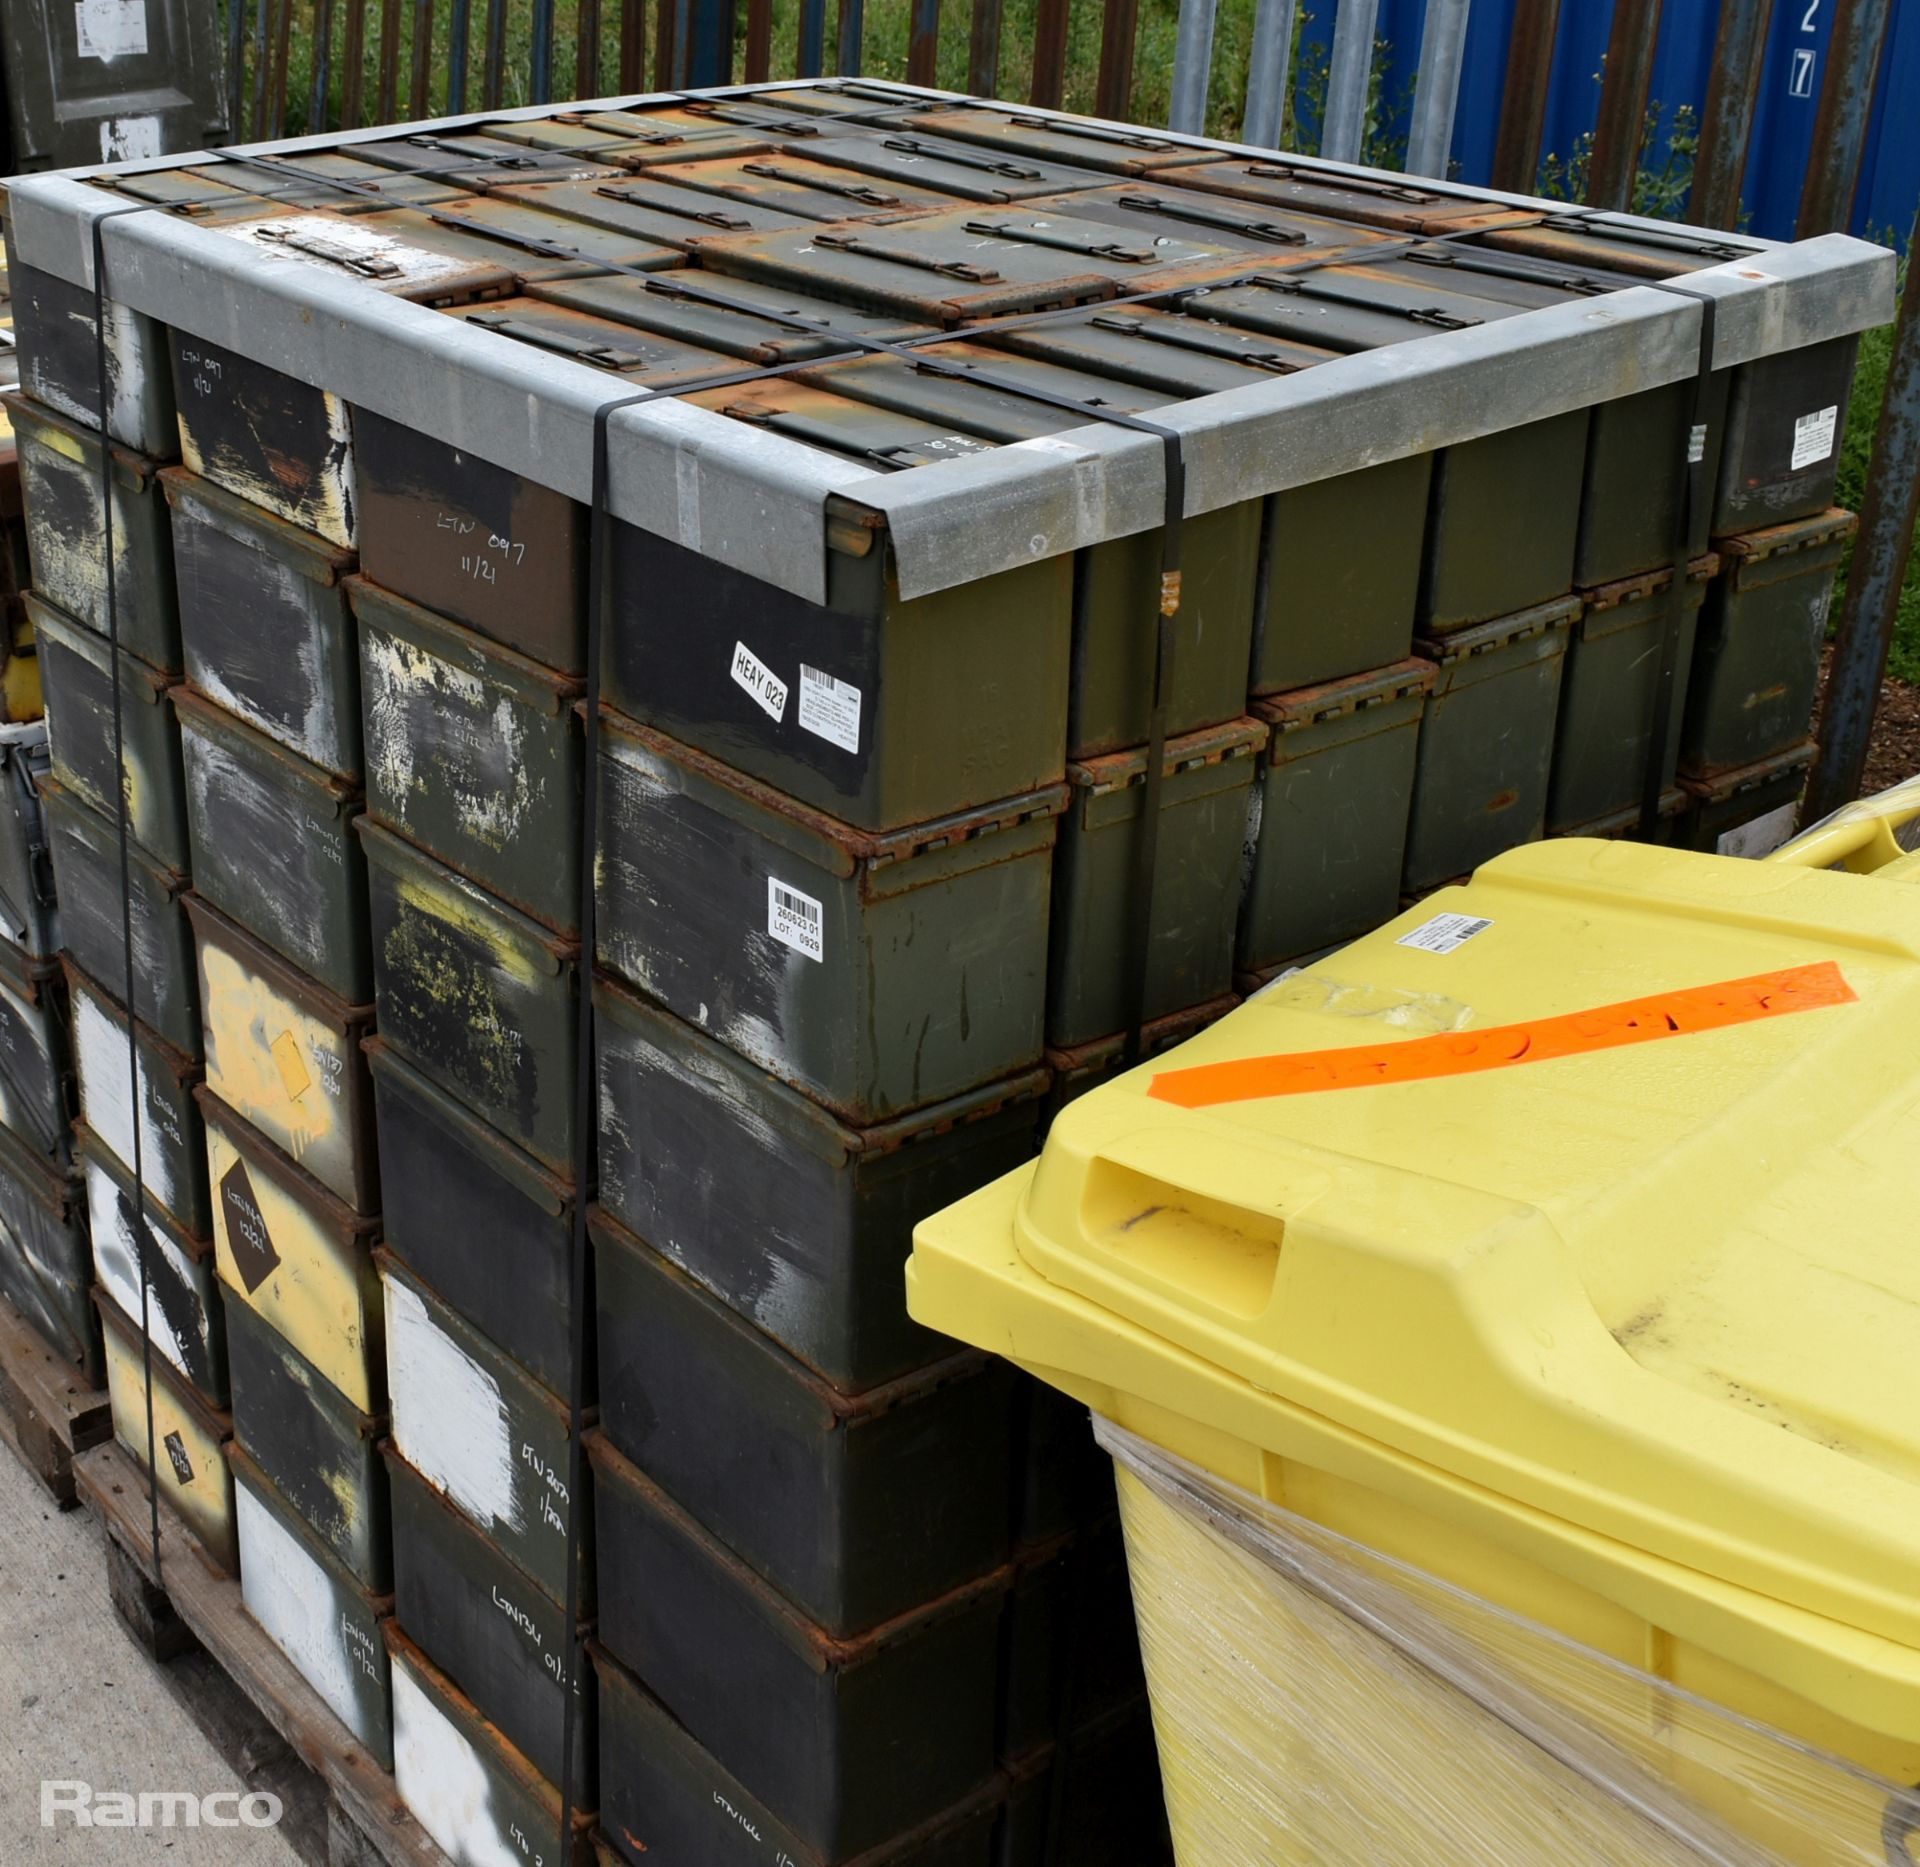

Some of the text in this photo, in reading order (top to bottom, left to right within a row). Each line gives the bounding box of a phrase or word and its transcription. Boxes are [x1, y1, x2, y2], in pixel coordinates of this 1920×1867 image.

[1796, 51, 1812, 93] 7
[437, 512, 525, 565] LTN 097
[462, 555, 495, 585] 11/21
[736, 651, 784, 711] HEAY 023
[778, 906, 807, 930] 260623
[774, 919, 820, 952] LOT: 0929
[522, 1443, 544, 1477] LTN
